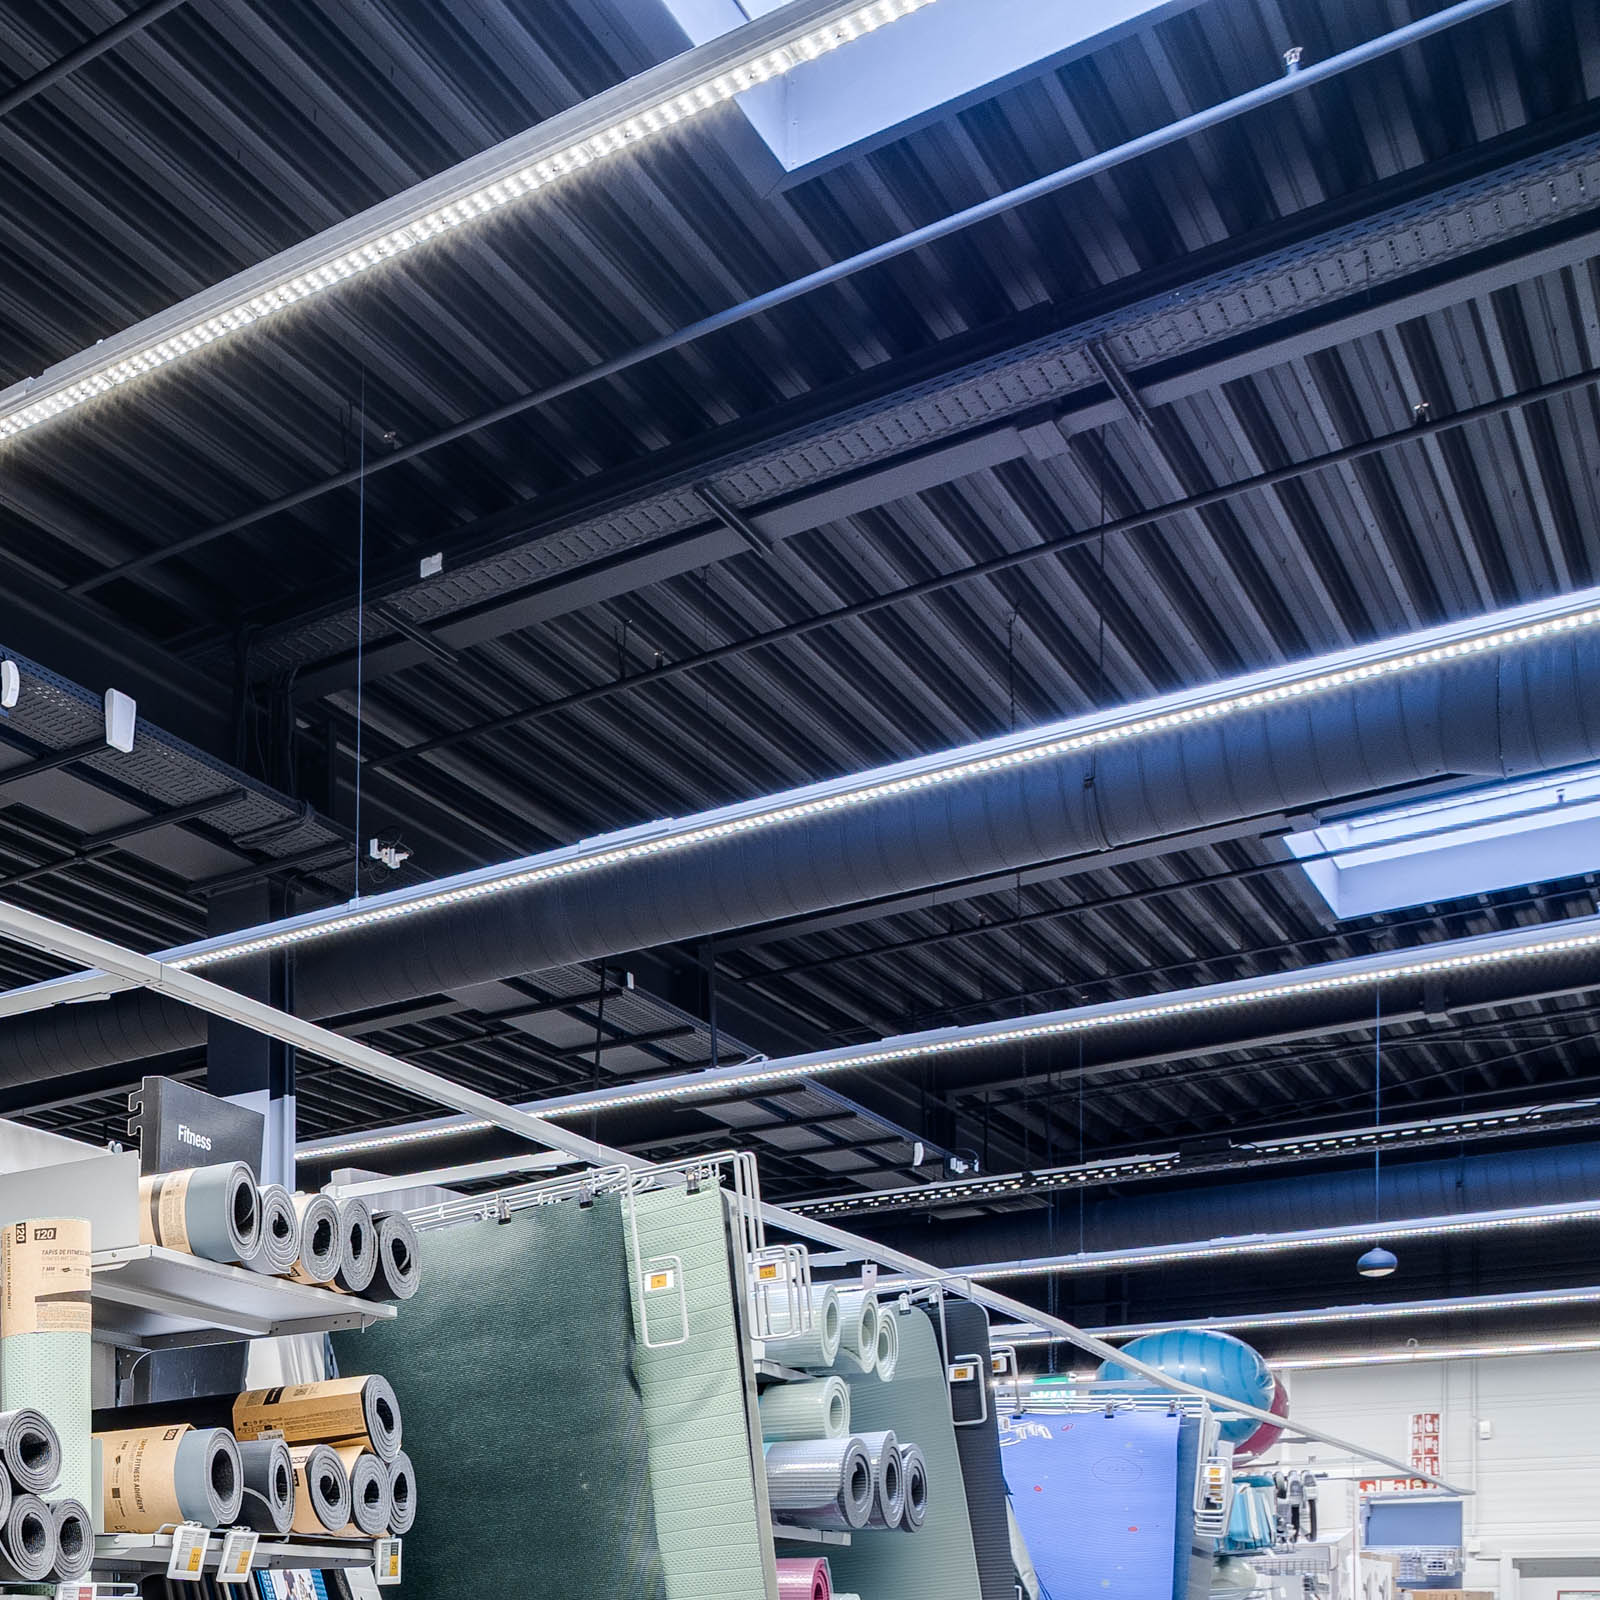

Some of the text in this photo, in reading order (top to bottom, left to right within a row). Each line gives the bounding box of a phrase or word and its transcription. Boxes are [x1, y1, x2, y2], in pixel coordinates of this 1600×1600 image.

[178, 1124, 212, 1151] Fitness
[17, 1224, 25, 1242] 120
[36, 1229, 54, 1240] 120
